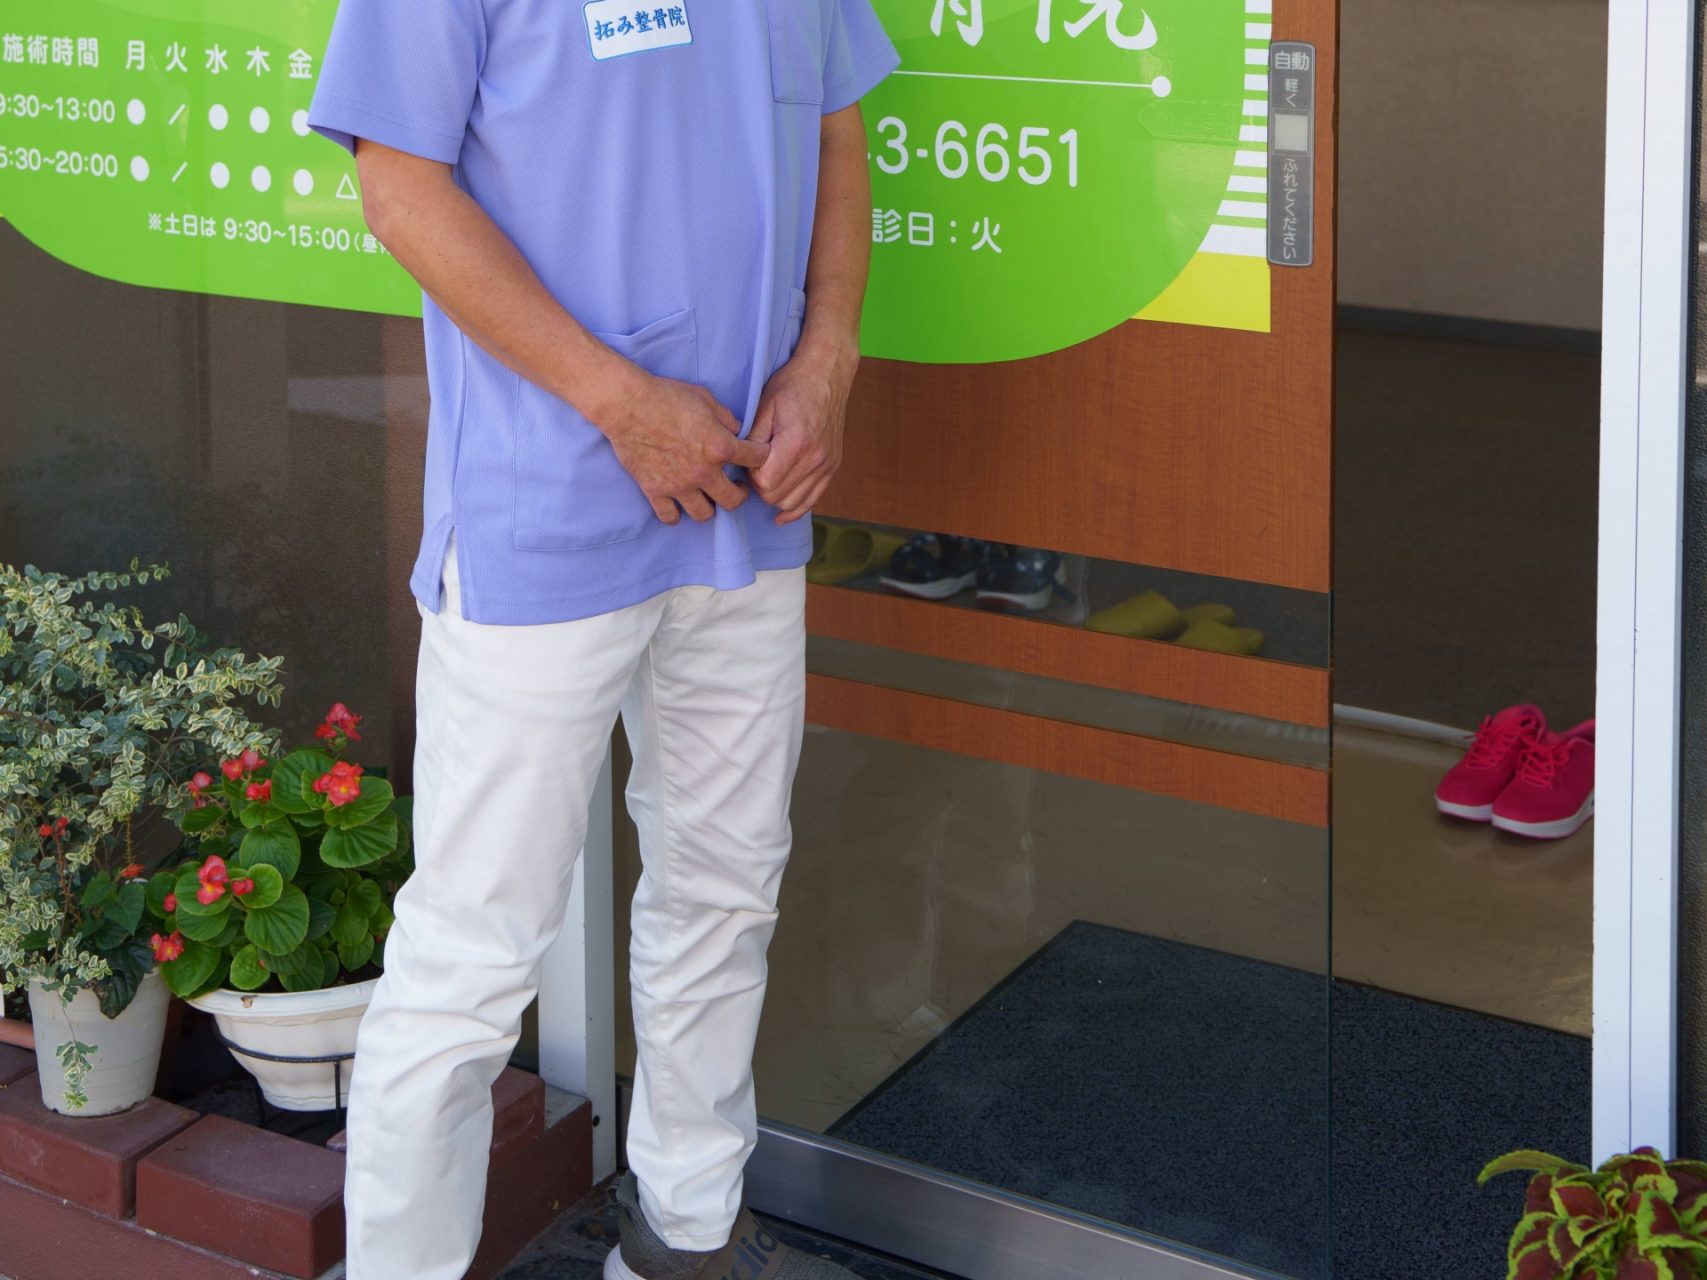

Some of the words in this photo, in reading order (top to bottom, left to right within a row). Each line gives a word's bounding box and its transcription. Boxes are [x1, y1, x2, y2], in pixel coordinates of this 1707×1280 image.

[594, 6, 686, 41] 拓み整骨院
[3, 33, 99, 68] 施術時間
[126, 40, 146, 71] 月
[165, 42, 188, 73] 火
[205, 44, 228, 75] 水
[246, 46, 271, 77] 木
[288, 49, 313, 79] 金
[1275, 50, 1310, 71] 自動
[1284, 78, 1299, 108] 軽く
[868, 116, 1078, 188] 3-6651
[1283, 158, 1298, 260] ふれてください
